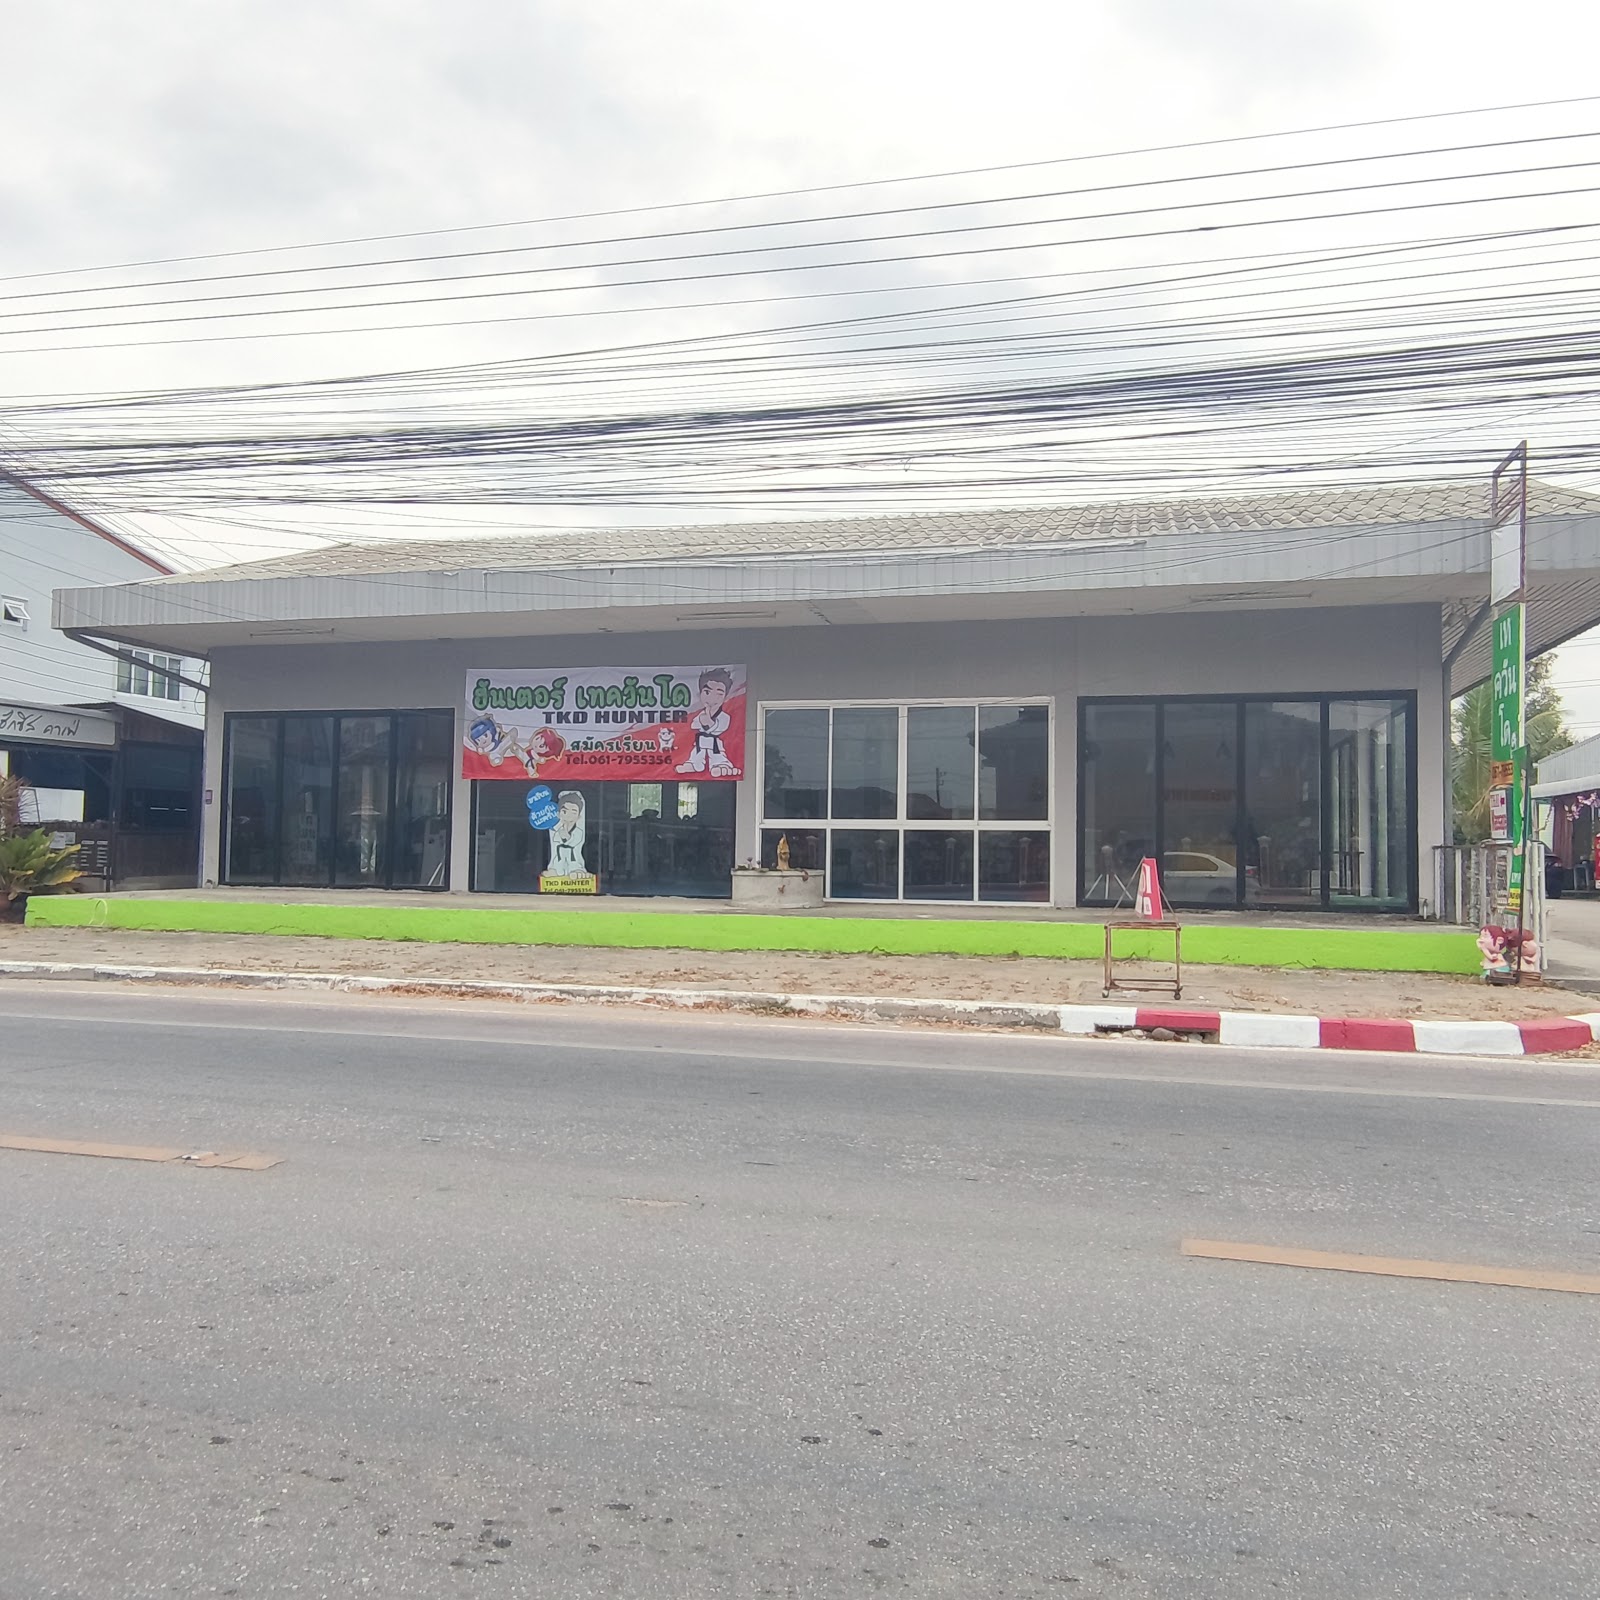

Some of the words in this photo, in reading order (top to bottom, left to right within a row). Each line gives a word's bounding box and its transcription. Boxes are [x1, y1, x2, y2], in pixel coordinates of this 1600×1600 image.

[472, 676, 568, 711] ฮันเตอร์
[575, 674, 692, 710] เทควันโด
[542, 711, 588, 724] TKD
[595, 710, 689, 724] HUNTER
[43, 719, 80, 737] คาเฟ่
[570, 736, 656, 753] สมัครเรียน
[565, 754, 673, 765] Tel.061-7955356
